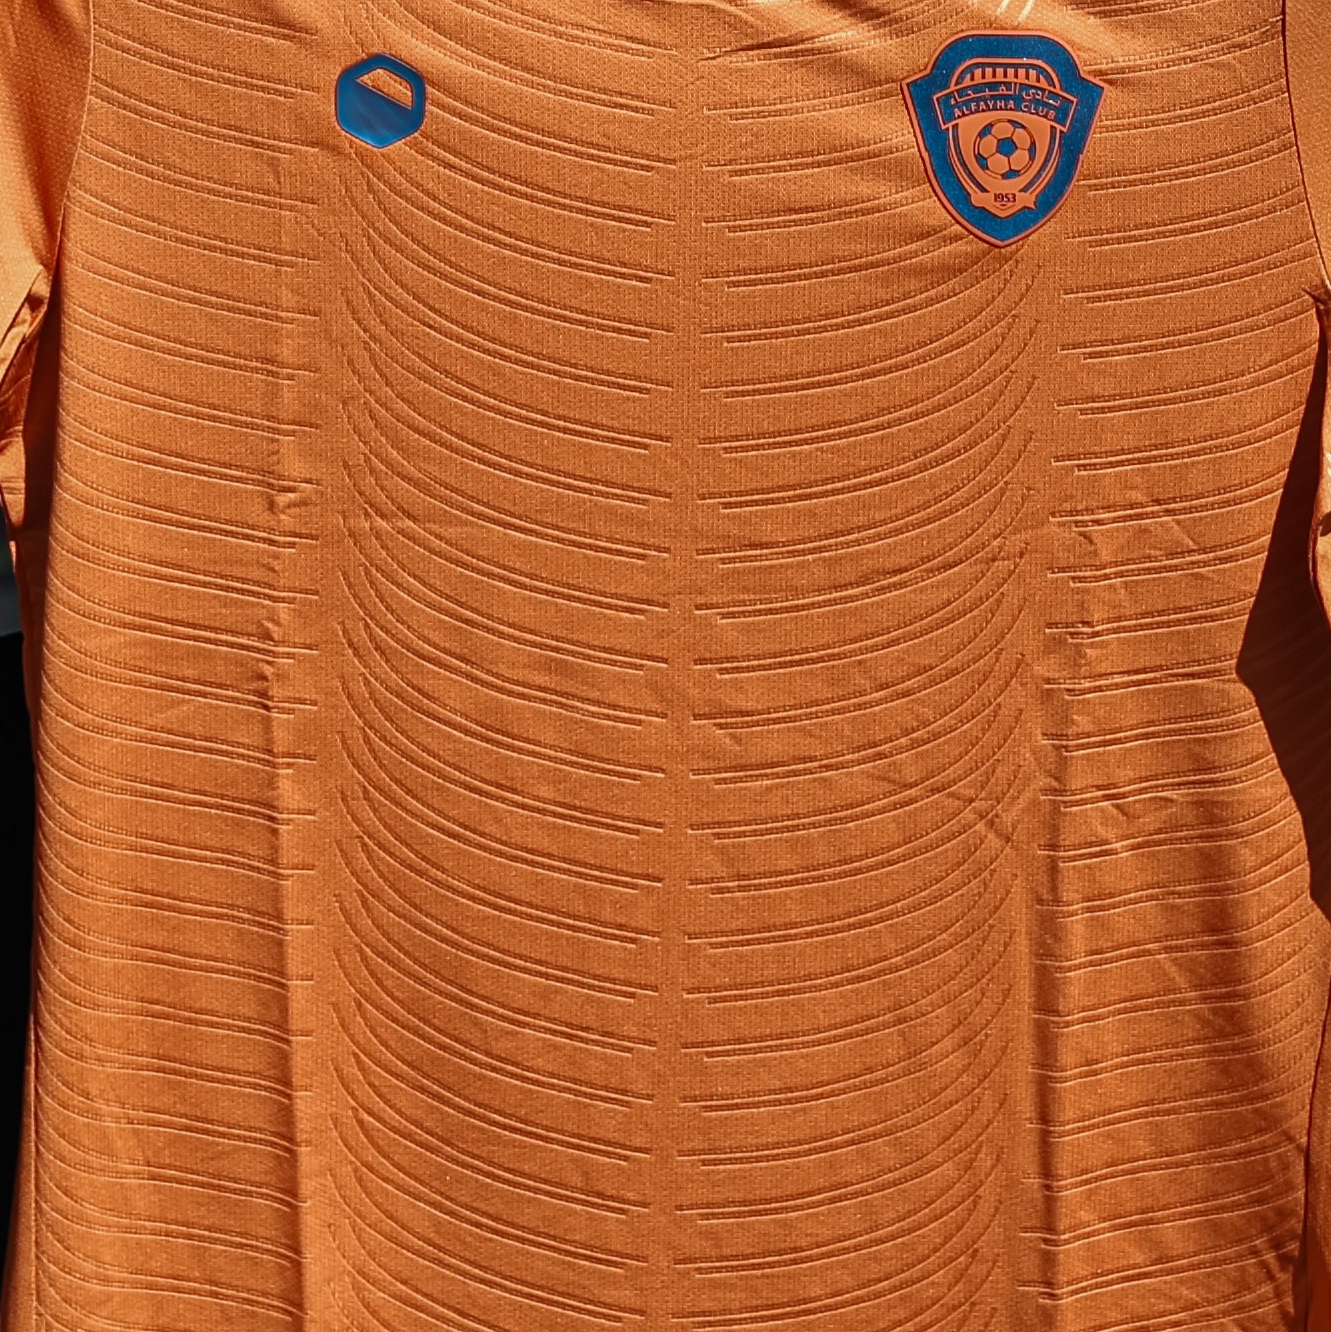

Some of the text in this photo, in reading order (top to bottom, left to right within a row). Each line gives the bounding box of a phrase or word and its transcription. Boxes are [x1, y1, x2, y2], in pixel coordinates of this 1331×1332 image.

[954, 100, 1056, 120] ALFAYHA CLUB
[994, 193, 1017, 203] 1953
